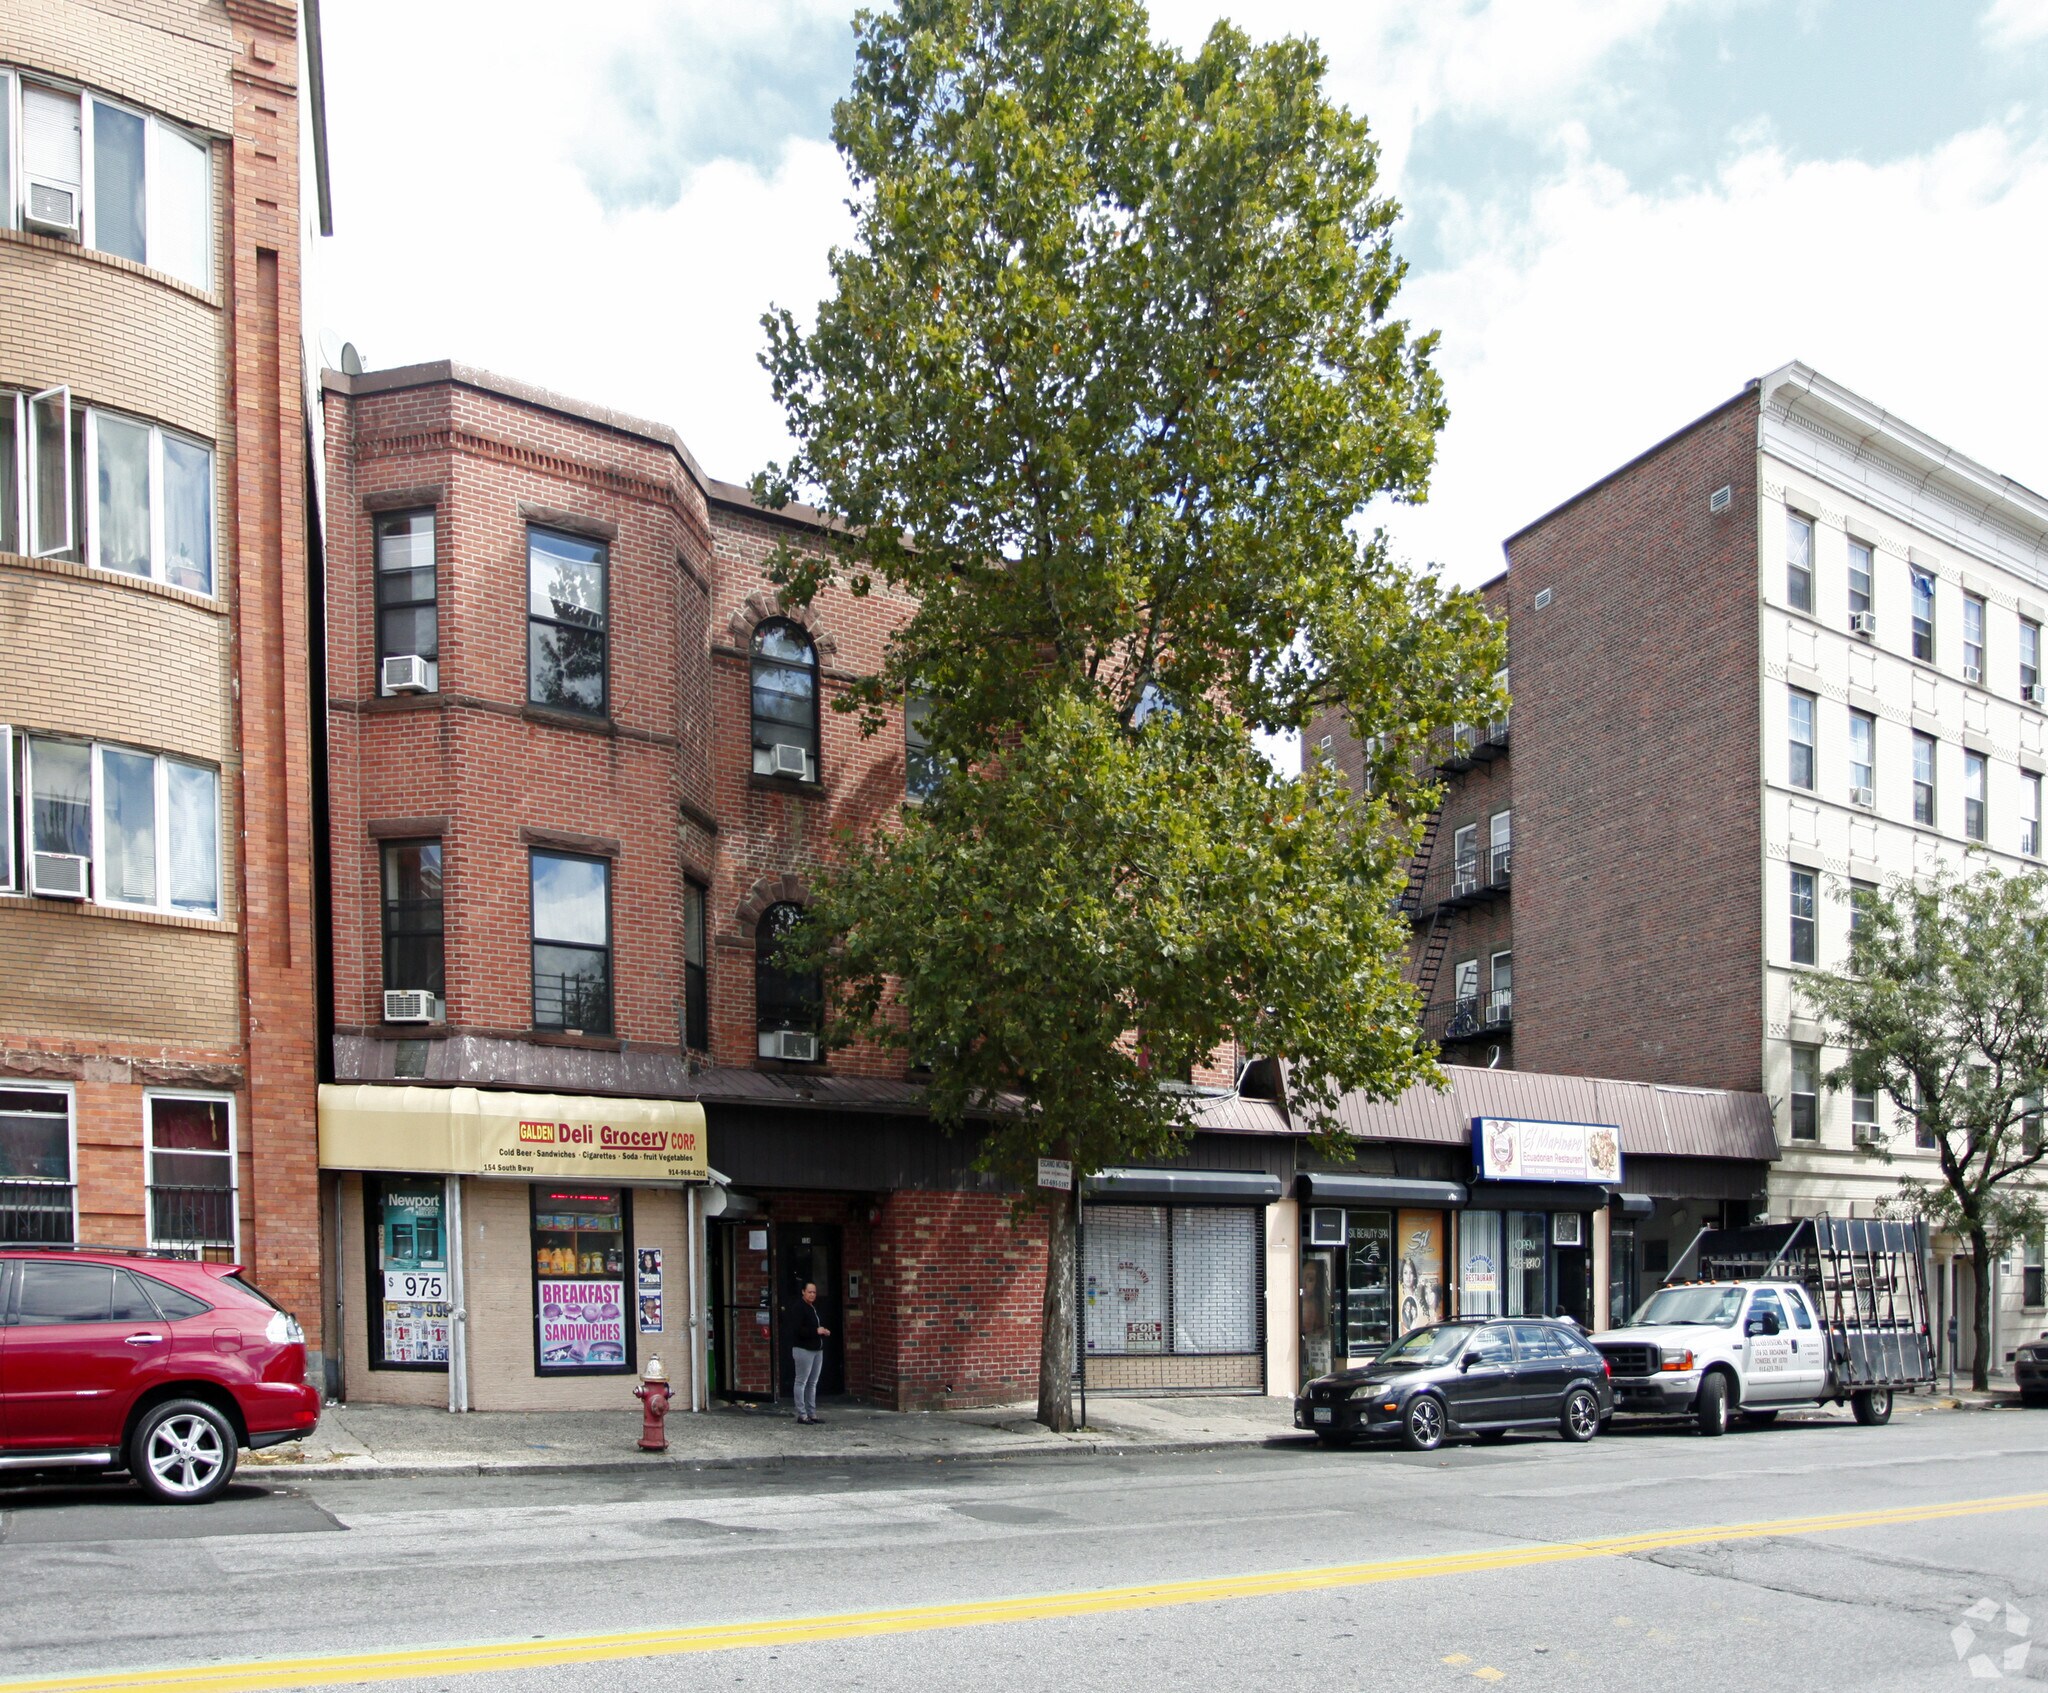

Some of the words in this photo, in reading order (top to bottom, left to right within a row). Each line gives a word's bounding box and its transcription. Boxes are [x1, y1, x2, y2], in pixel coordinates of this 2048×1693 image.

[520, 1124, 553, 1141] GALDEN
[559, 1123, 593, 1144] Deli
[600, 1125, 669, 1150] Grocery
[671, 1133, 696, 1151] CORP.
[499, 1148, 515, 1156] Cold
[516, 1149, 532, 1157] Beer
[536, 1149, 576, 1158] Sandwiches
[582, 1150, 616, 1160] Cigarettes
[622, 1152, 638, 1160] Soda
[643, 1153, 657, 1161] fruit
[659, 1153, 693, 1163] Vegetables
[1523, 1151, 1554, 1163] Ecuadorian
[1555, 1152, 1584, 1164] Restaurant
[497, 1164, 516, 1172] South
[518, 1165, 534, 1173] Bway
[388, 1193, 440, 1208] Newport
[1356, 1228, 1378, 1239] BEAUTY
[1378, 1229, 1389, 1239] SPA
[1514, 1239, 1536, 1250] OPEN
[388, 1276, 394, 1287] $
[1465, 1273, 1496, 1282] RESTAURANT
[542, 1284, 620, 1304] BREAKFAST
[544, 1323, 620, 1341] SANDWICHES
[1132, 1323, 1156, 1332] FOR
[1128, 1332, 1160, 1341] RENT
